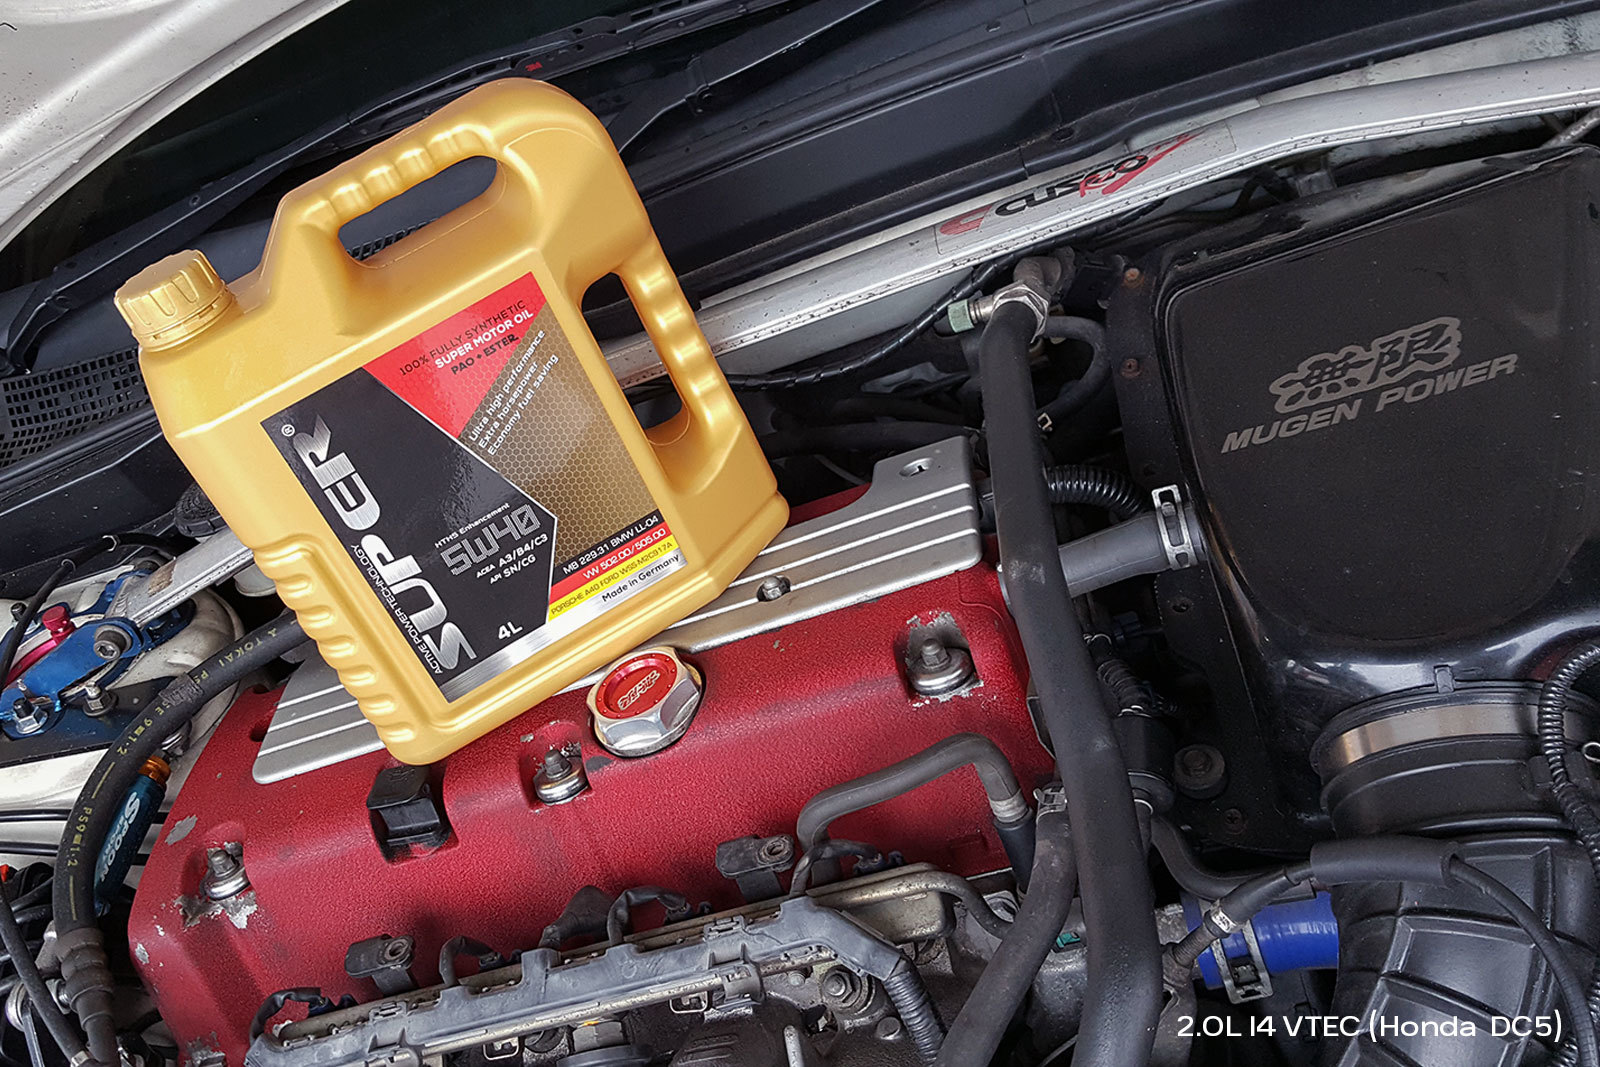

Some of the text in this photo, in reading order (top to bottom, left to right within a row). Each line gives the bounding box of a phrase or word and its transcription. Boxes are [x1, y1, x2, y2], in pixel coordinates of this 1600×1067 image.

[399, 300, 527, 377] 100% FULLY SYNTHETIC
[434, 309, 534, 369] SUPER MOTOR OIL
[450, 358, 476, 375] PAO
[483, 333, 519, 357] ESTER
[469, 330, 546, 442] Ultra high performance
[479, 361, 539, 449] Extra horsepower
[488, 354, 559, 456] Economy fuel saving
[1220, 353, 1519, 453] MUGEN POWER
[293, 413, 478, 670] SUPER
[440, 504, 541, 576] 5W40
[459, 502, 511, 535] Enhancement
[562, 515, 659, 575] MB 229.31 BMW LL-04
[476, 533, 548, 578] ACEA A3/B4/C3
[490, 553, 536, 585] API SN/CG
[582, 527, 666, 580] VW 502.00/505.00
[602, 553, 680, 602] Made in Germany
[350, 544, 443, 674] ACTIVE POWER TECHNOLOGY
[551, 593, 585, 615] PORSCHE
[585, 583, 600, 595] A40
[600, 572, 620, 587] FORD
[219, 637, 263, 667] TOKAI
[498, 621, 523, 640] 4L
[101, 791, 140, 882] SPOON
